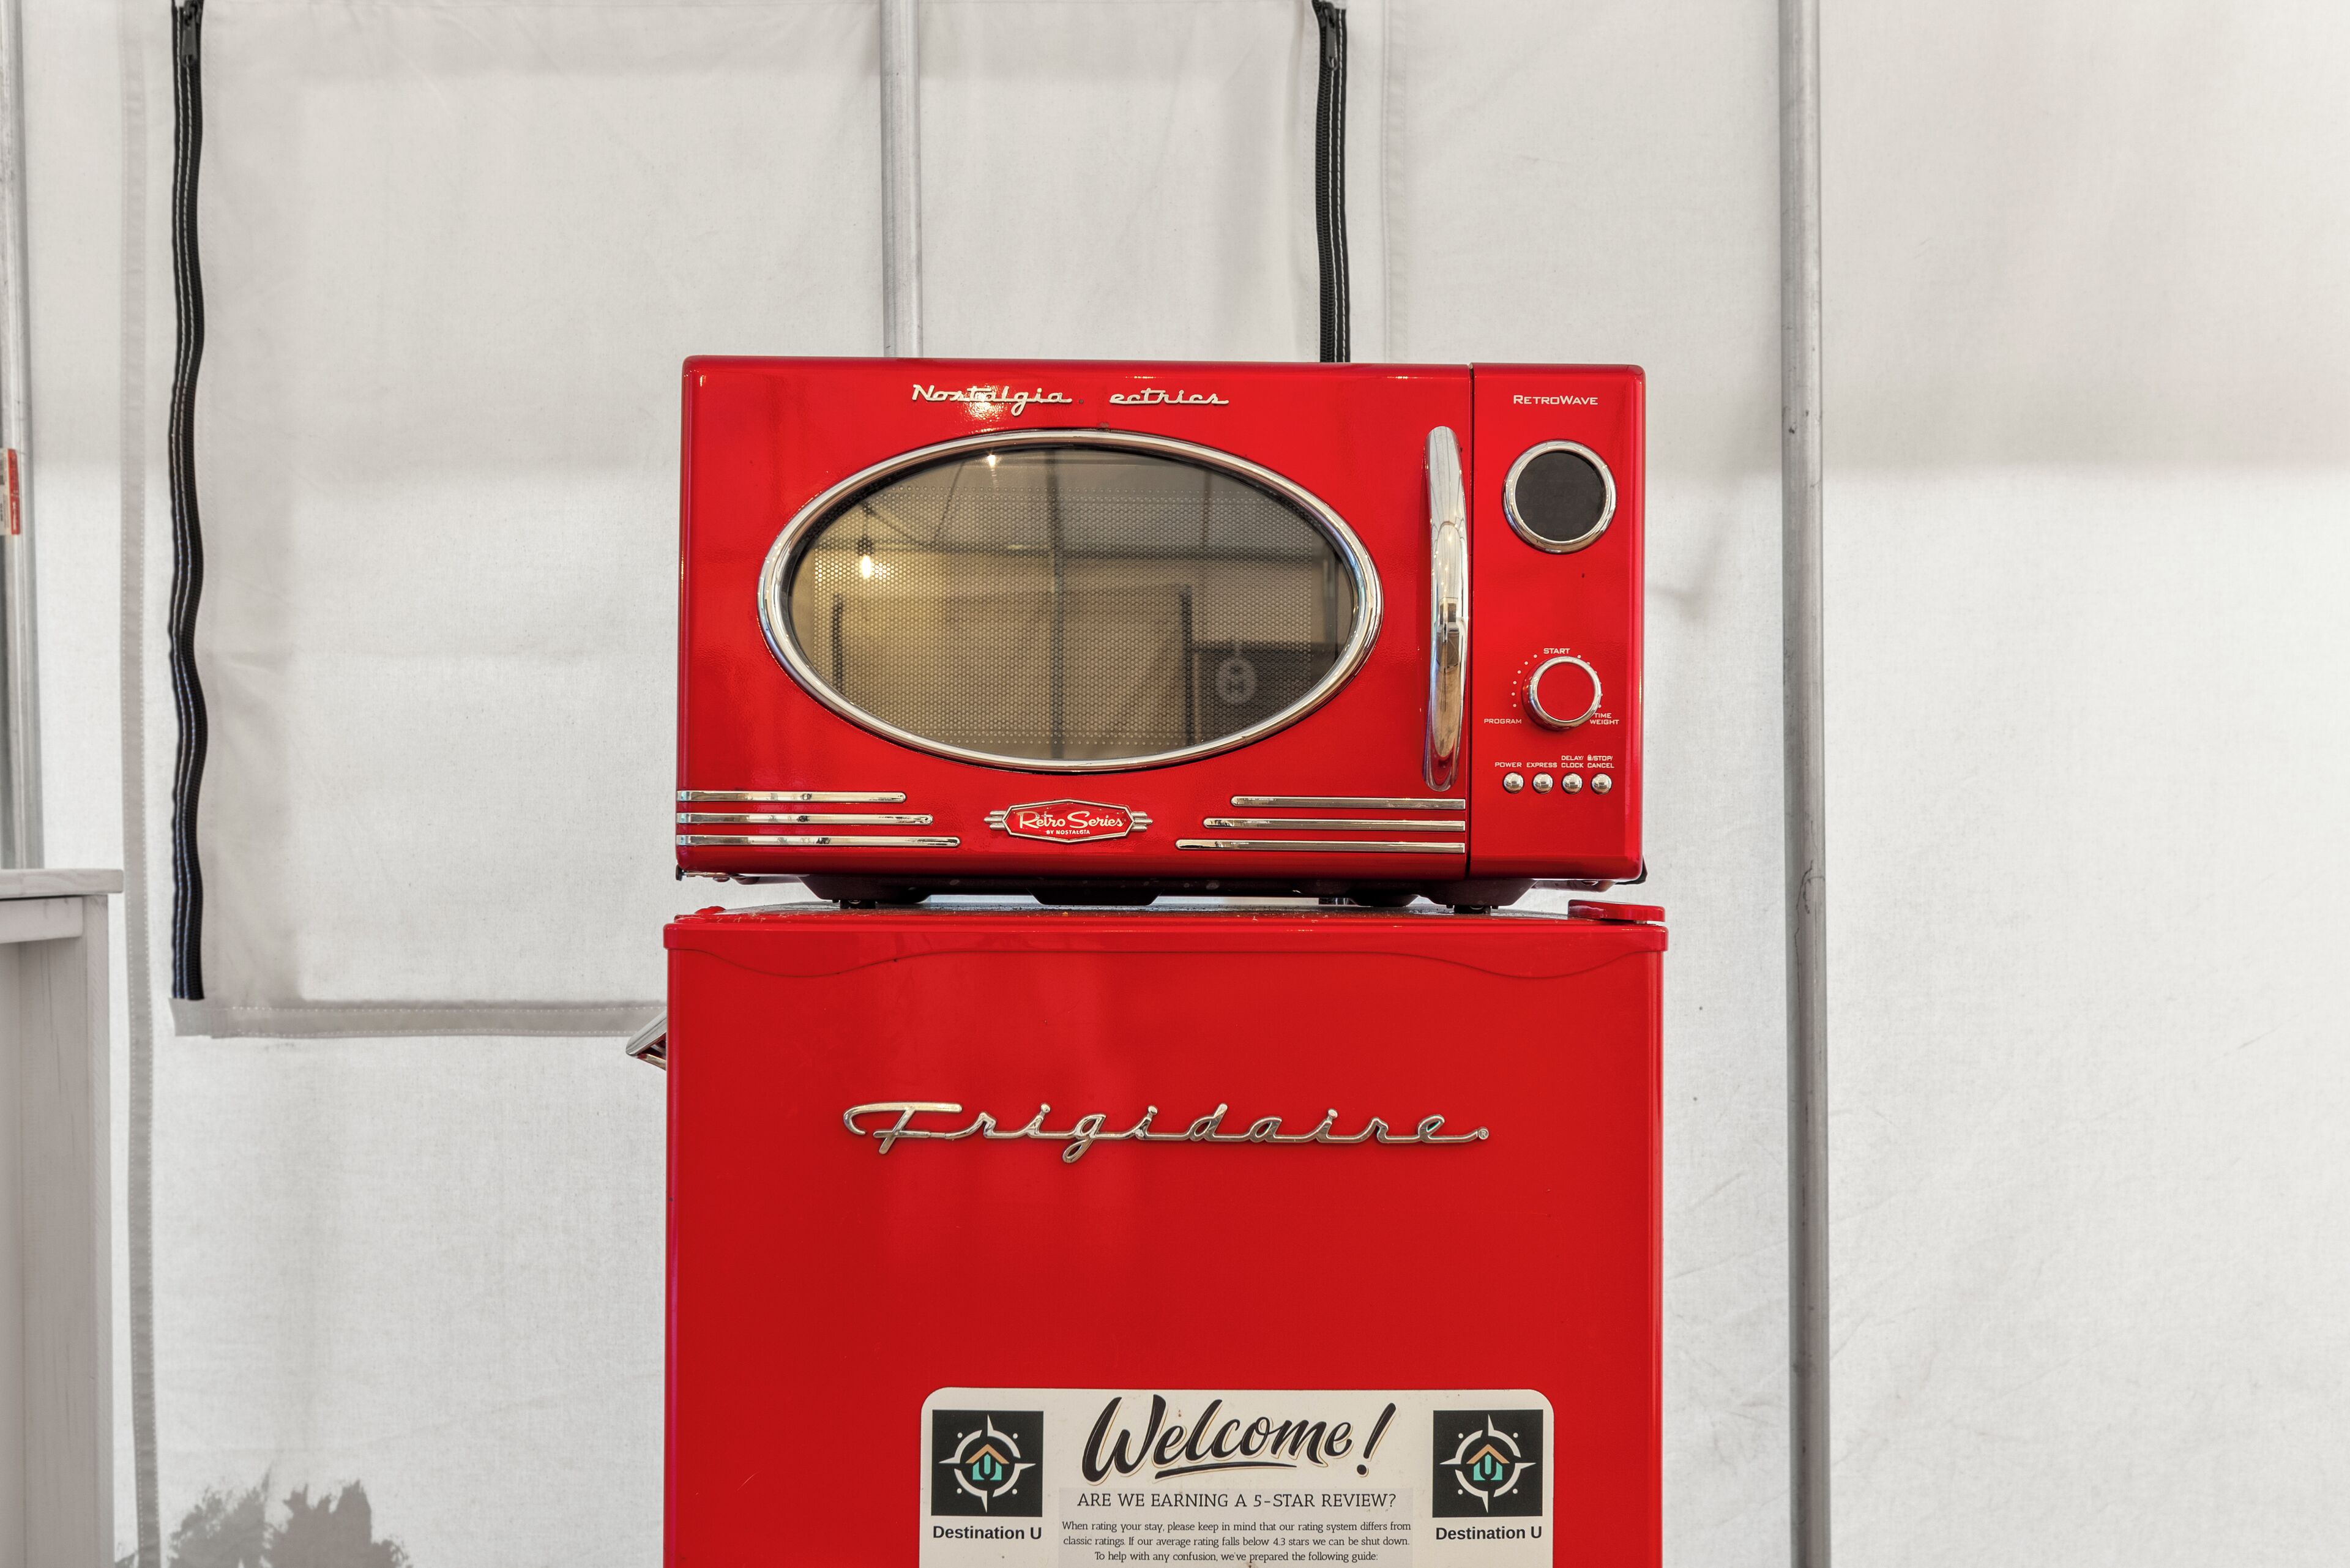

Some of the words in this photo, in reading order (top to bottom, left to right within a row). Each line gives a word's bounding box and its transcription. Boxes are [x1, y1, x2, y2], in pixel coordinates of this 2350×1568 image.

[912, 384, 1072, 417] Nostalgia
[1016, 810, 1066, 829] Retro
[1081, 1393, 1397, 1484] Welcome!
[1077, 1493, 1111, 1507] ARE
[1117, 1493, 1145, 1507] WE
[1151, 1493, 1228, 1507] EARNING
[1234, 1493, 1247, 1507] A
[1253, 1493, 1315, 1507] 5-STAR
[1321, 1493, 1397, 1507] REVIEW?
[933, 1526, 1025, 1540] Destination
[1030, 1526, 1042, 1539] U
[1062, 1521, 1088, 1531] When
[1091, 1521, 1117, 1533] rating
[1120, 1523, 1141, 1533] your
[1144, 1523, 1165, 1533] stay,
[1167, 1521, 1195, 1533] please
[1198, 1521, 1219, 1533] keep
[1222, 1522, 1230, 1531] in
[1233, 1521, 1256, 1531] mind
[1259, 1521, 1276, 1531] that
[1298, 1521, 1324, 1533] rating
[1326, 1523, 1357, 1533] system
[1360, 1521, 1388, 1531] differs
[1390, 1521, 1411, 1531] from
[1436, 1526, 1526, 1540] Destination
[1531, 1526, 1542, 1539] U
[1063, 1536, 1092, 1545] classic
[1095, 1537, 1126, 1548] ratings.
[1128, 1537, 1135, 1545] If
[1156, 1538, 1191, 1548] average
[1193, 1537, 1219, 1548] rating
[1222, 1537, 1240, 1546] falls
[1243, 1537, 1269, 1546] below
[1348, 1537, 1359, 1546] be
[1361, 1537, 1380, 1545] shut
[1382, 1537, 1410, 1545] down.
[1094, 1551, 1105, 1560] To
[1108, 1551, 1127, 1562] help
[1130, 1551, 1150, 1561] with
[1152, 1553, 1169, 1563] any
[1173, 1552, 1218, 1562] confusion,
[1220, 1552, 1247, 1561] we've
[1249, 1552, 1289, 1563] prepared
[1292, 1552, 1306, 1561] the
[1308, 1551, 1349, 1563] following
[1351, 1551, 1378, 1562] guide:
